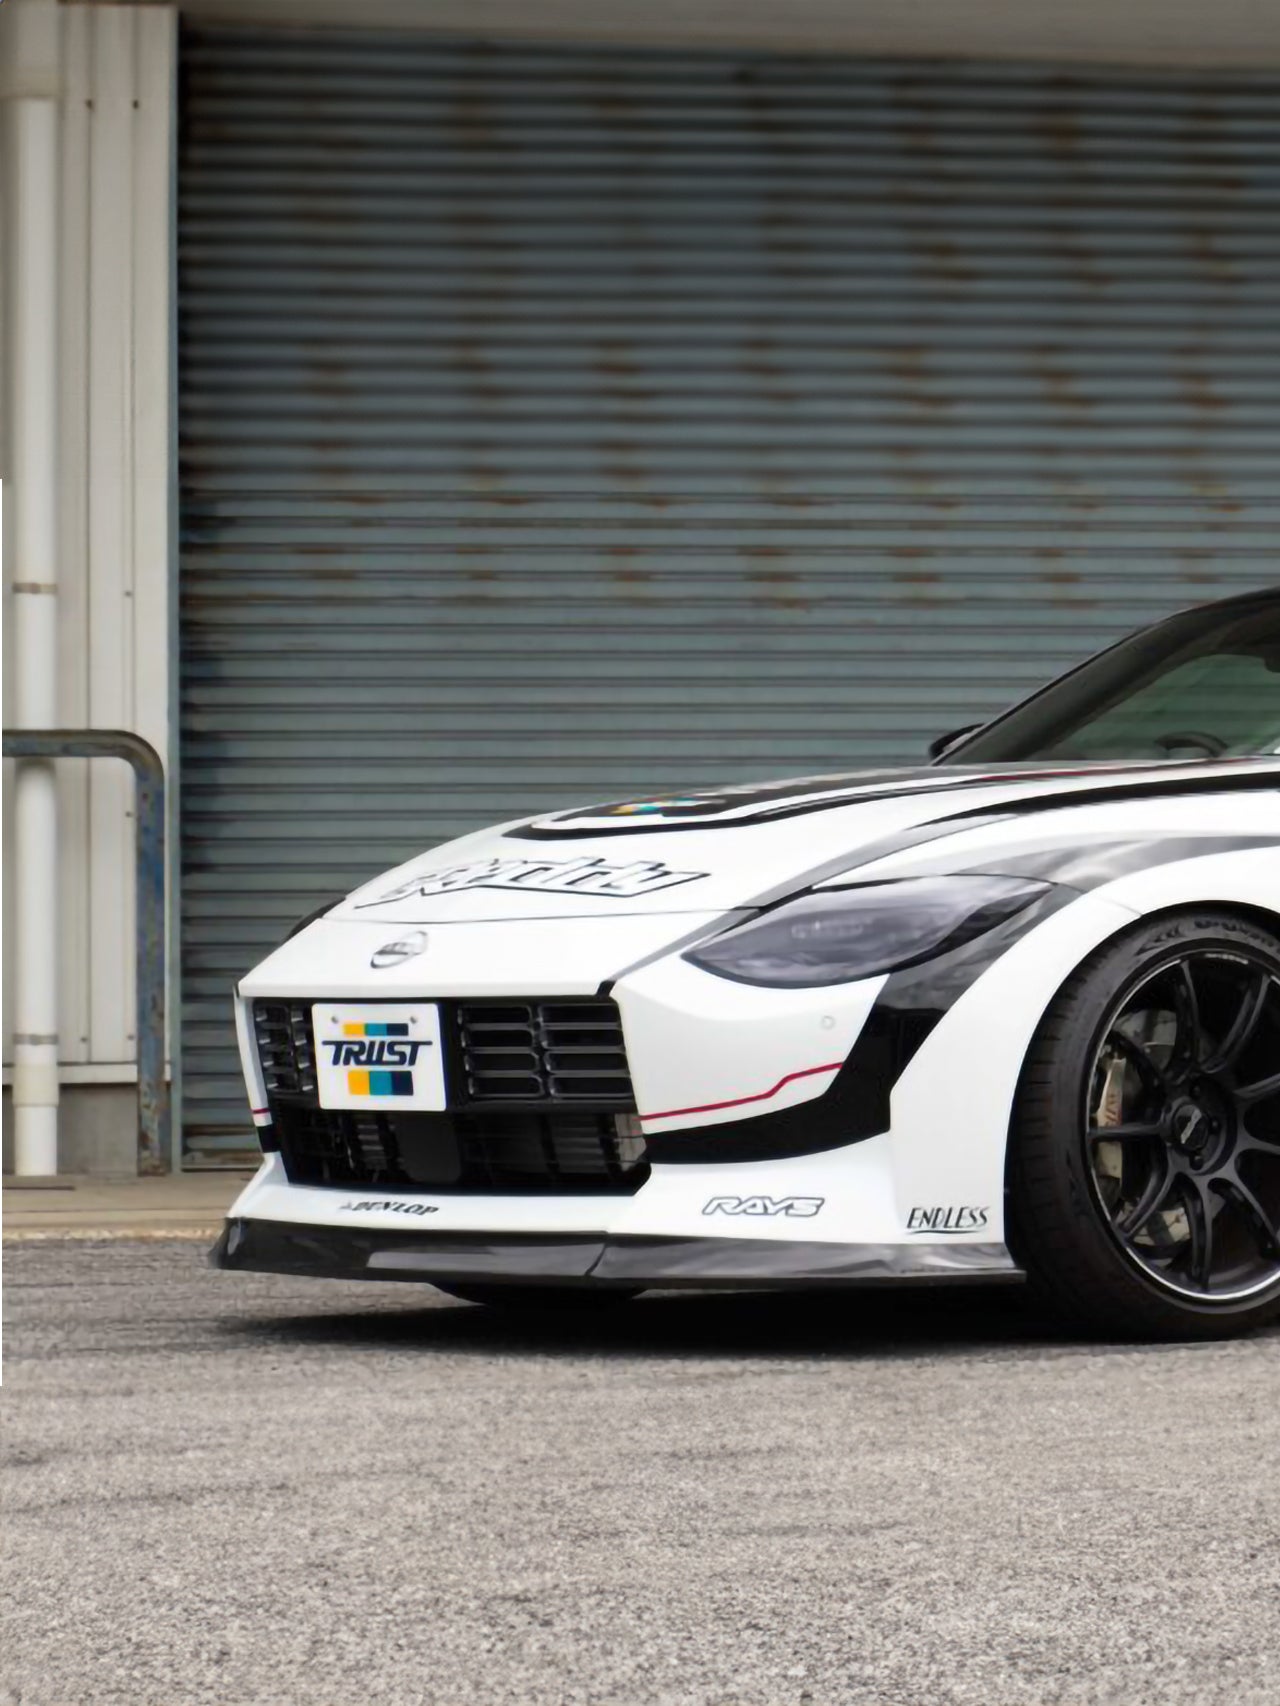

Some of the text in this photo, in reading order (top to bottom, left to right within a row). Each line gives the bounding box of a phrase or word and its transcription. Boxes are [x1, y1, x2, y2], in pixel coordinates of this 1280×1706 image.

[321, 1040, 433, 1067] TRUST
[702, 1196, 825, 1218] RAYS
[906, 1206, 990, 1230] ENDLESS
